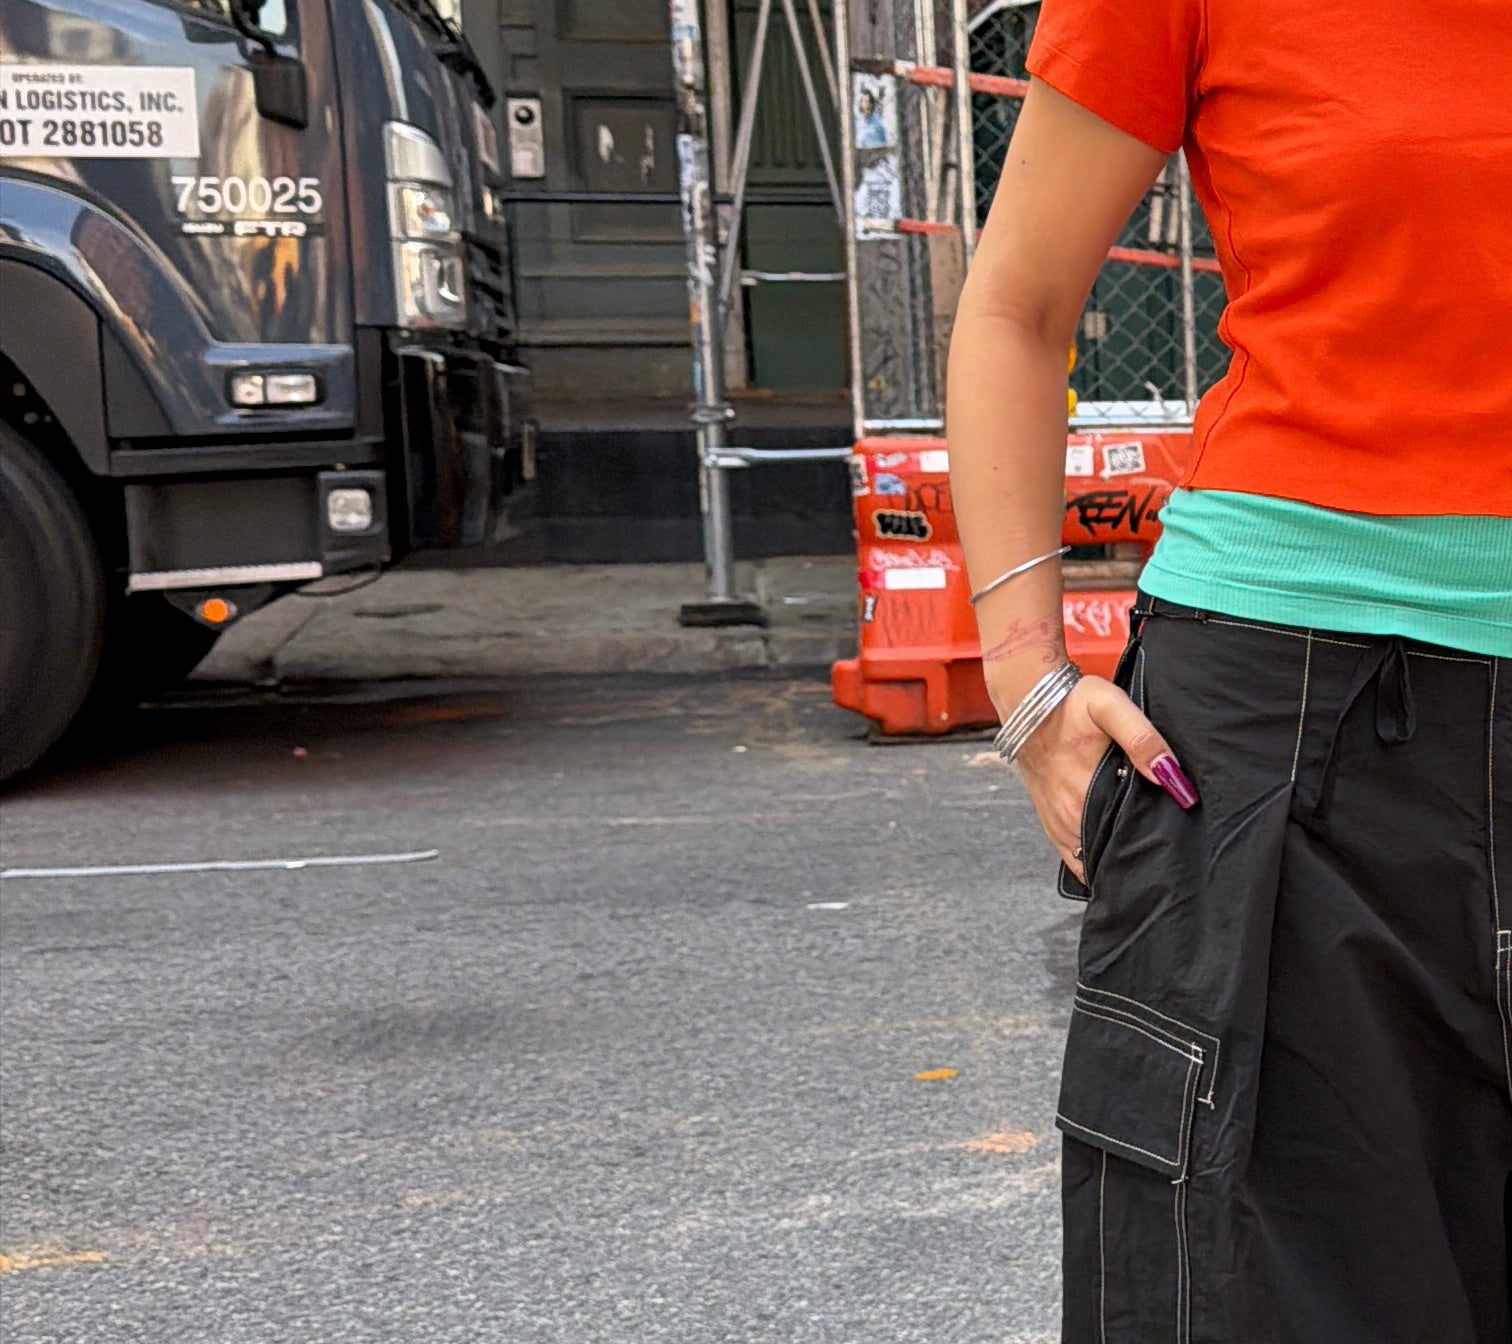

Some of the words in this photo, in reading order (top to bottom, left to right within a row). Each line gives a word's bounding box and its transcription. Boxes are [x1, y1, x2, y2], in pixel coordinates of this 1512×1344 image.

[15, 89, 133, 113] LOGISTICS,
[139, 91, 184, 113] INC.
[42, 119, 163, 148] 2881058
[171, 176, 323, 213] 750025
